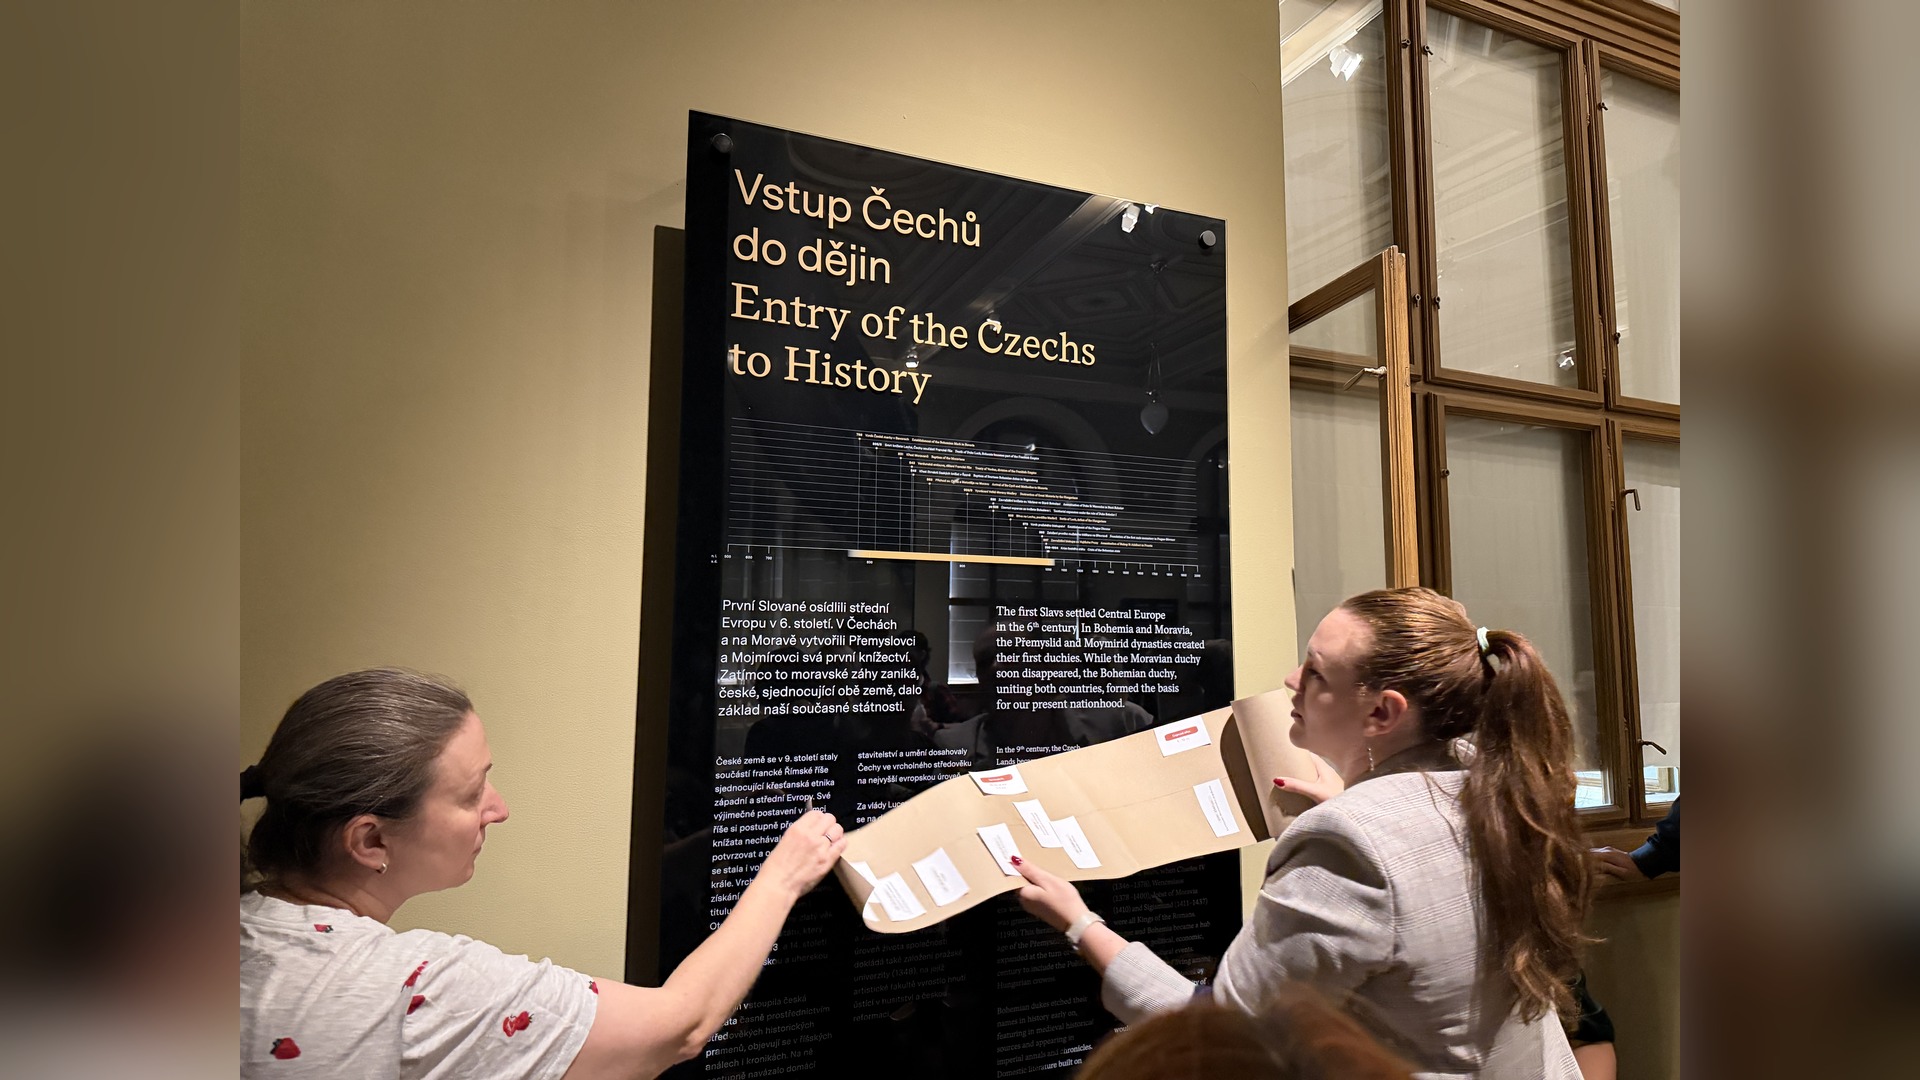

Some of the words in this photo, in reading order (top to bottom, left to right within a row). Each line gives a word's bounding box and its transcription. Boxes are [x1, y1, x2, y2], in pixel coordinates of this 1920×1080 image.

[734, 168, 851, 229] Vstup
[862, 186, 982, 247] Čechů
[732, 227, 787, 266] do
[799, 238, 891, 286] dějin
[731, 282, 851, 341] Entry
[861, 305, 905, 339] of
[909, 312, 968, 350] the
[977, 322, 1096, 366] Czechs
[729, 342, 771, 378] to
[784, 346, 932, 405] History
[723, 600, 755, 610] První
[759, 600, 806, 611] Slované
[810, 602, 846, 612] osídlili
[850, 602, 889, 613] střední
[996, 606, 1016, 616] The
[1019, 606, 1037, 616] first
[1040, 607, 1063, 617] Slavs
[1066, 609, 1096, 618] settled
[1098, 609, 1131, 618] Central
[1134, 610, 1165, 622] Europe
[723, 617, 766, 630] Evropu
[770, 620, 776, 628] v
[780, 618, 790, 628] 6.
[794, 618, 833, 628] století.
[836, 619, 844, 628] V
[847, 616, 896, 629] Čechách
[996, 622, 1006, 631] in
[1009, 622, 1024, 631] the
[1042, 624, 1078, 635] century
[1081, 623, 1091, 632] In
[1094, 623, 1134, 633] Bohemia
[1136, 625, 1152, 633] and
[1155, 625, 1192, 636] Moravia,
[721, 637, 728, 645] a
[733, 637, 747, 645] na
[752, 635, 796, 645] Moravě
[800, 635, 845, 647] vytvořili
[850, 635, 915, 647] Přemyslovci
[996, 637, 1012, 646] the
[1015, 637, 1061, 649] Přemyslid
[1064, 639, 1081, 648] and
[1084, 638, 1129, 650] Moymirid
[1131, 639, 1172, 650] dynasties
[1174, 640, 1204, 649] created
[721, 655, 727, 663] a
[732, 652, 799, 665] Mojmírovci
[803, 652, 822, 662] svá
[826, 652, 856, 664] první
[859, 652, 910, 662] knížectví.
[996, 653, 1020, 662] their
[1022, 652, 1041, 662] first
[1044, 653, 1082, 662] duchies.
[1084, 653, 1111, 662] While
[1113, 653, 1128, 663] the
[1131, 654, 1172, 663] Moravian
[1175, 654, 1201, 665] duchy
[719, 669, 772, 680] Zatímco
[775, 670, 788, 679] to
[792, 668, 848, 679] moravské
[851, 668, 878, 680] záhy
[881, 668, 919, 680] zaniká,
[1022, 668, 1081, 680] disappeared,
[1083, 668, 1098, 677] the
[1101, 668, 1146, 677] Bohemian
[1148, 669, 1177, 680] duchy,
[719, 687, 759, 699] české,
[763, 685, 835, 699] sjednocující
[838, 685, 860, 696] obě
[863, 685, 895, 697] země,
[899, 685, 922, 695] dalo
[996, 684, 1032, 696] uniting
[1034, 684, 1056, 693] both
[1059, 684, 1104, 694] countries,
[1106, 683, 1139, 692] formed
[1141, 683, 1155, 692] the
[1158, 683, 1179, 692] basis
[719, 704, 759, 716] základ
[764, 703, 790, 714] naší
[793, 702, 849, 714] současné
[853, 701, 904, 712] státnosti.
[997, 699, 1011, 709] for
[1032, 700, 1067, 711] present
[1070, 698, 1125, 708] nationhood.
[716, 756, 741, 765] České
[744, 756, 765, 764] země
[794, 754, 818, 762] století
[820, 753, 838, 761] staly
[858, 750, 897, 759] stavitelství
[905, 749, 927, 757] umění
[929, 748, 967, 756] dosahovaly
[858, 763, 881, 772] Čechy
[934, 760, 971, 768] středověku
[997, 758, 1017, 767] Lands
[716, 770, 750, 779] součástí
[753, 768, 782, 777] francké
[785, 766, 812, 775] Římské
[869, 775, 897, 785] nejvyšší
[899, 774, 935, 782] evropskou
[715, 782, 764, 794] sjednocující
[766, 780, 809, 789] křesťanská
[811, 779, 834, 787] etnika
[715, 797, 747, 807] západní
[756, 794, 785, 803] střední
[714, 810, 755, 821] výjimečné
[757, 807, 796, 818] postavení
[713, 825, 728, 833] říše
[740, 822, 778, 833] postupně
[713, 839, 742, 847] knížata
[745, 835, 782, 844] nechával
[712, 851, 756, 862] potvrzovat
[723, 865, 743, 874] stala
[711, 878, 734, 888] krále.
[711, 891, 740, 902] získání
[710, 906, 732, 916] titulu
[1058, 1059, 1073, 1067] built
